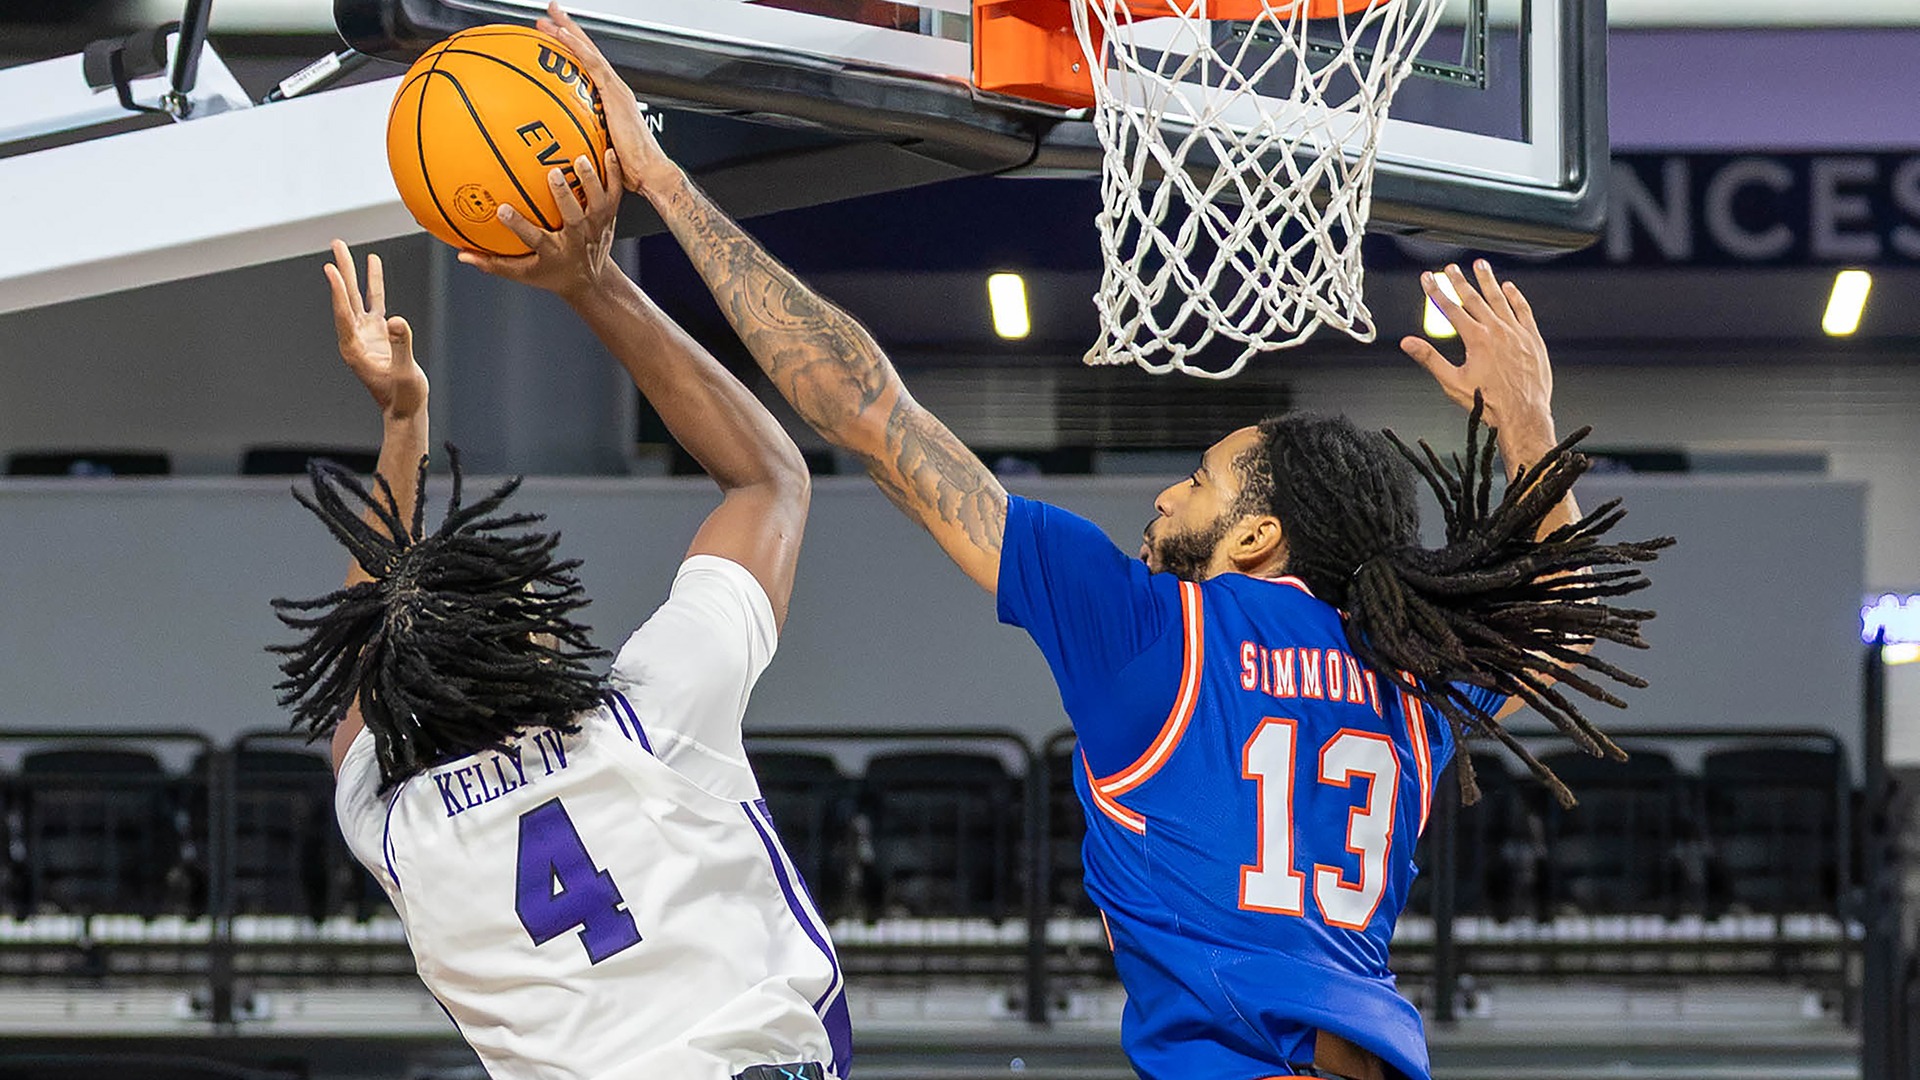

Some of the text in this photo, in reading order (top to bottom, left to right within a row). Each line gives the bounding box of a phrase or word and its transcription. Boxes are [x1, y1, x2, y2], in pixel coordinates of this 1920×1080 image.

[433, 729, 569, 818] KELLY IV
[1238, 716, 1401, 932] 13
[515, 796, 643, 965] 4
